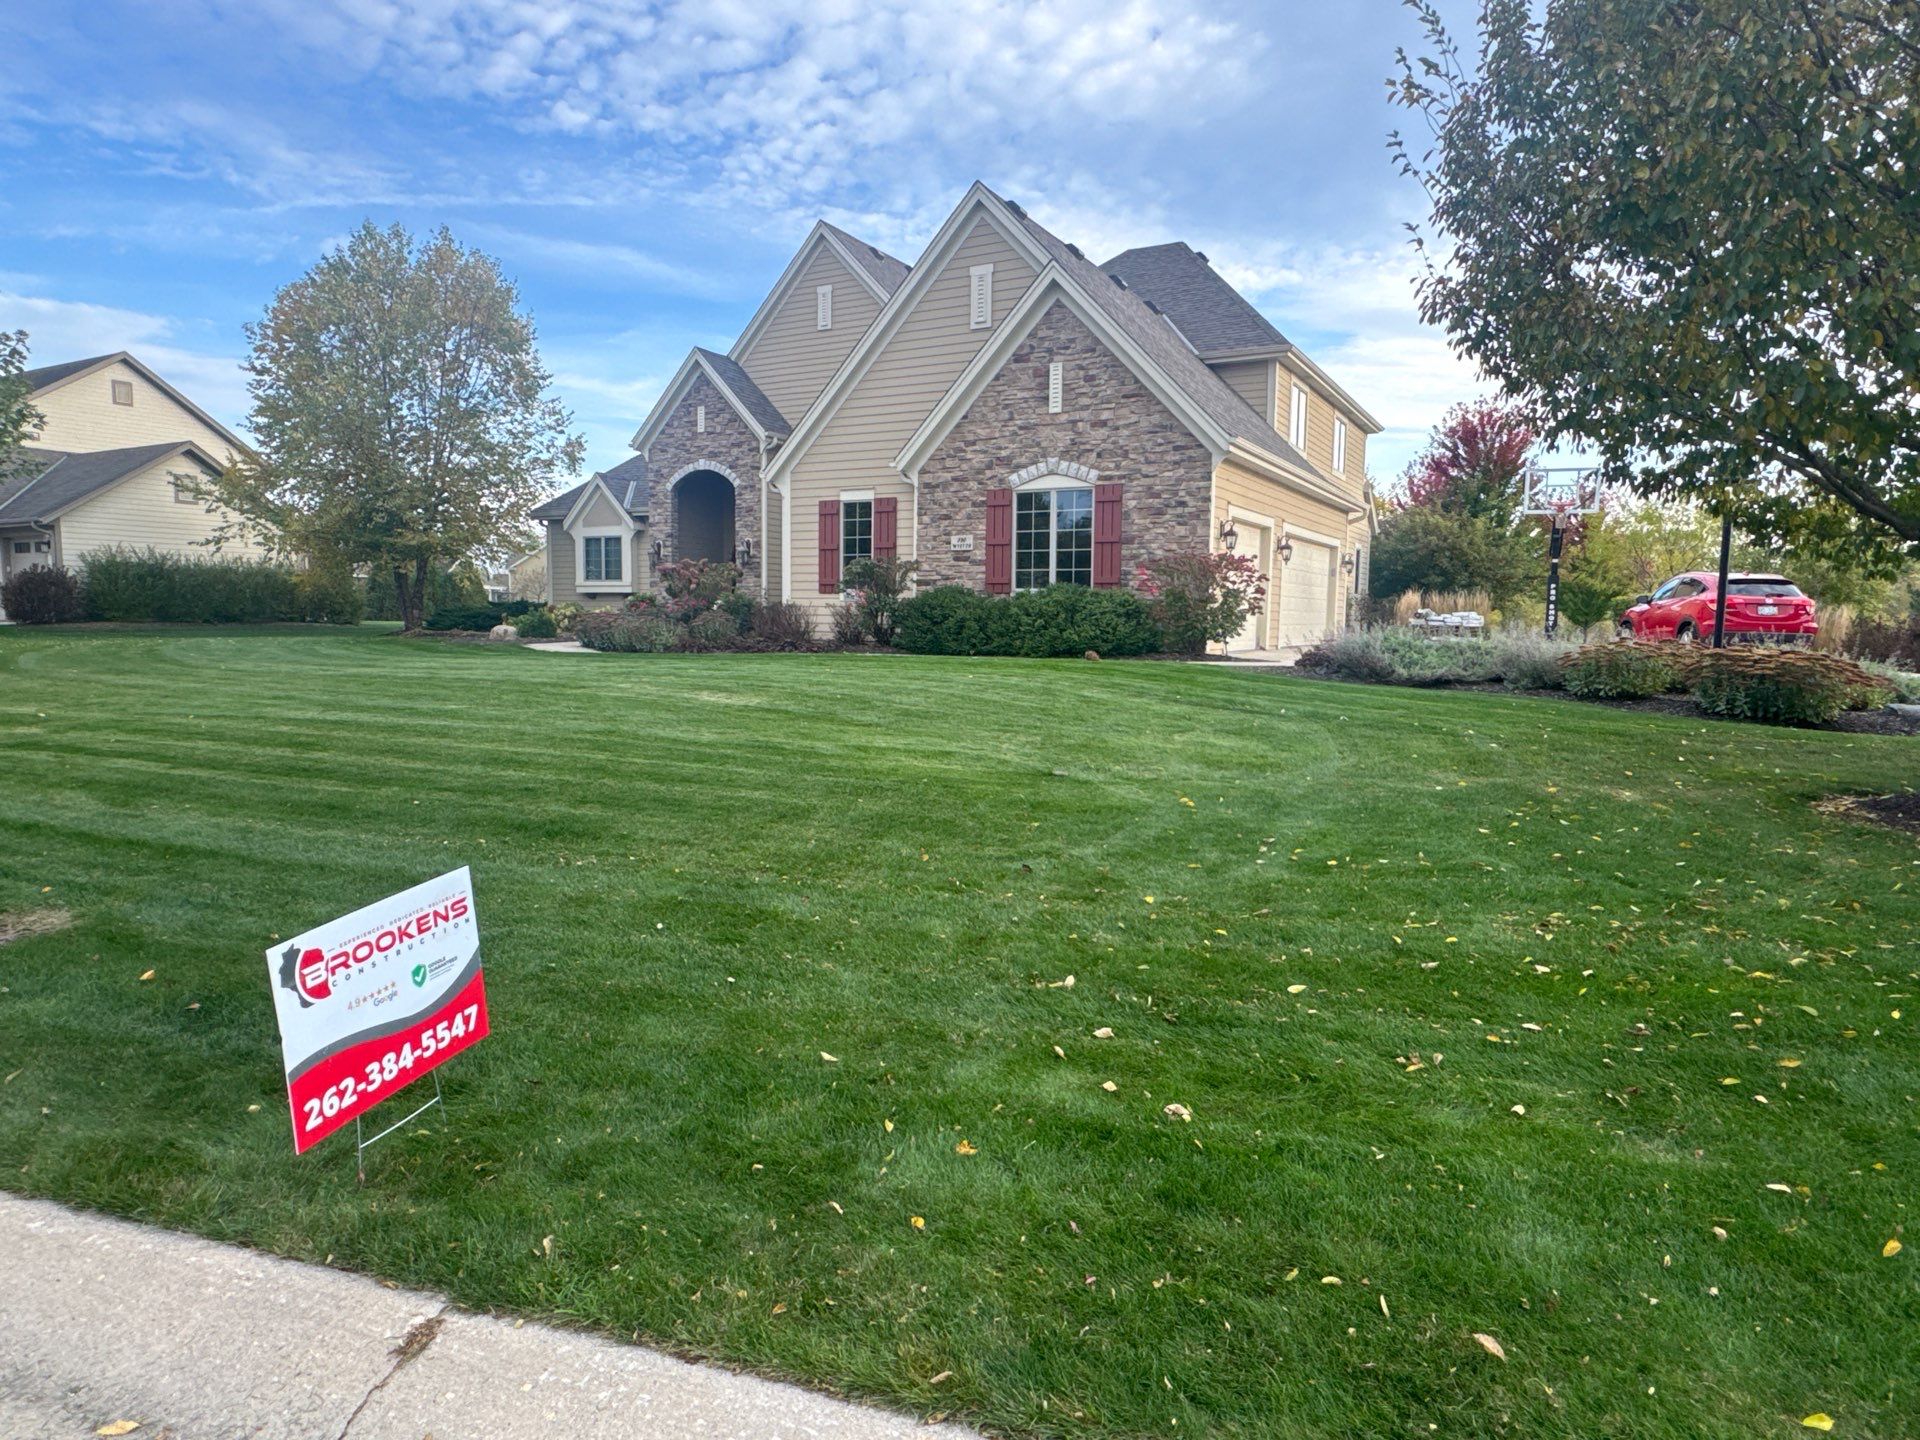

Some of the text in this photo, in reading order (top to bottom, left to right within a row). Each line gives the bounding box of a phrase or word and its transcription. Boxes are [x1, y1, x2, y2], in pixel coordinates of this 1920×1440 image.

[1548, 583, 1557, 627] PRO SHOT
[300, 896, 469, 991] BROOKENS
[331, 917, 470, 988] CONSTRUCTION
[373, 989, 398, 1007] Google
[303, 1003, 478, 1133] 262-384-5547
